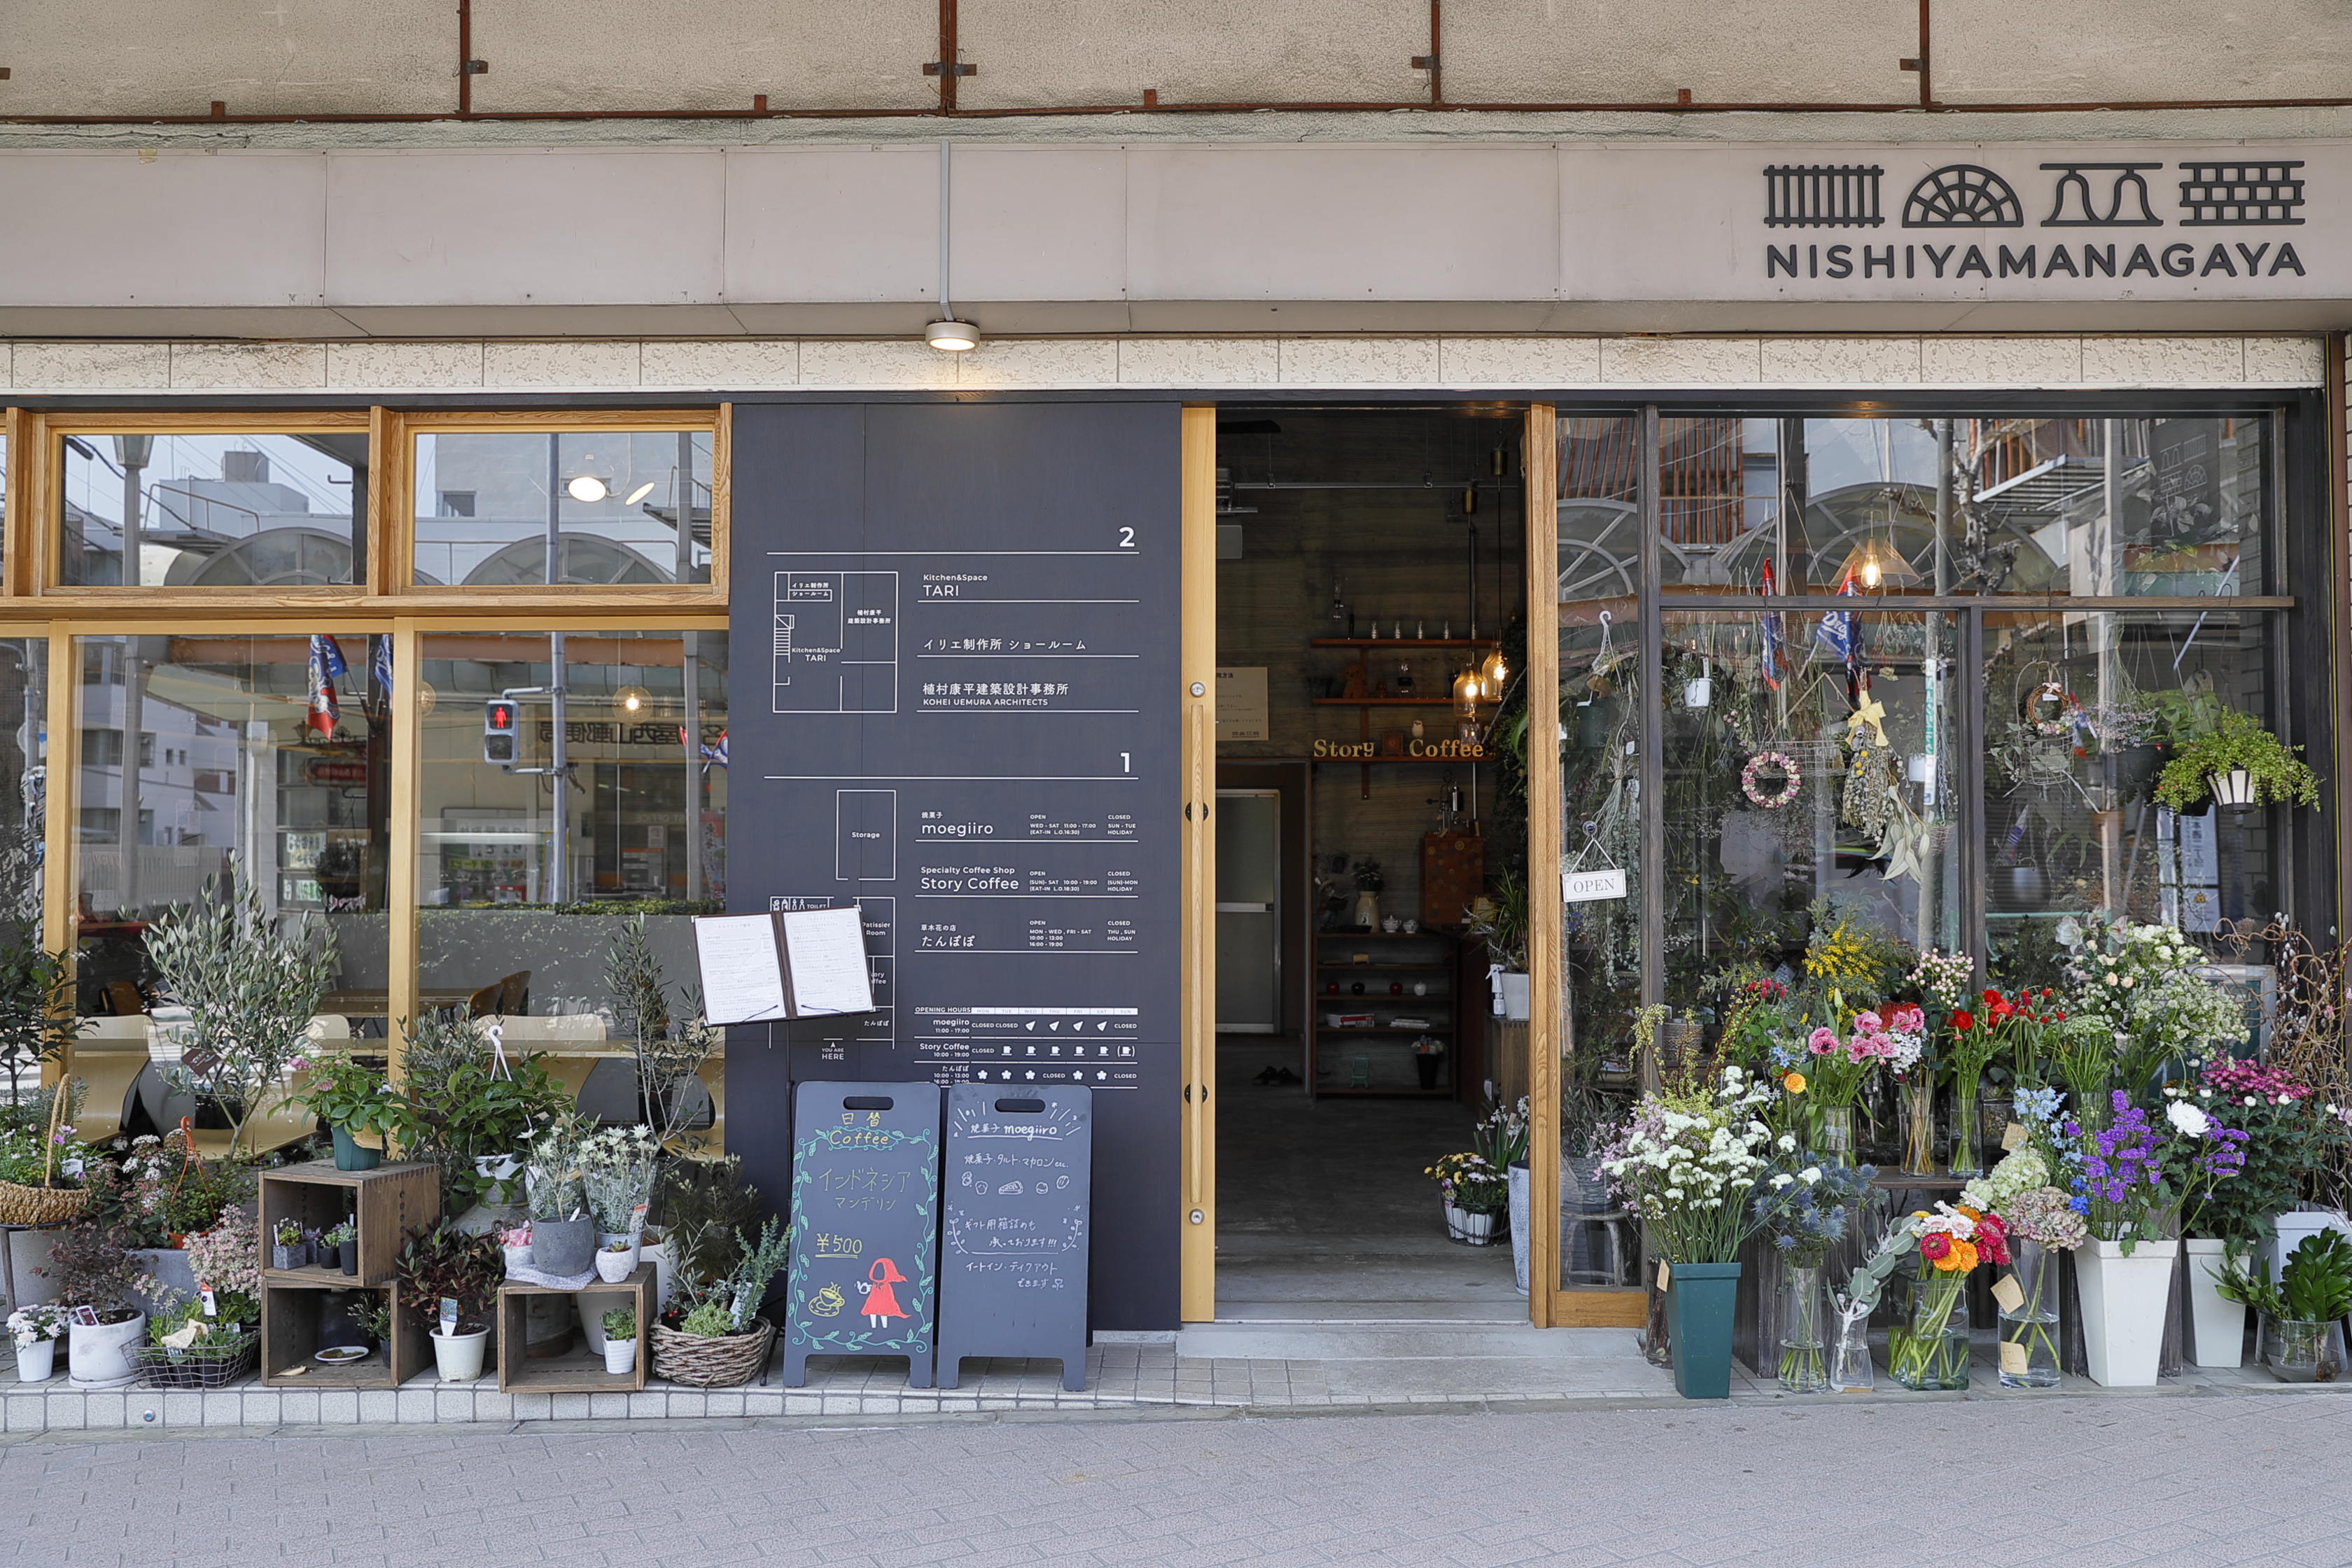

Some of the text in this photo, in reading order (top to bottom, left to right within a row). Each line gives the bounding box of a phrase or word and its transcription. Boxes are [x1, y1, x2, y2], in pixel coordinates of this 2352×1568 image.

[1767, 242, 2306, 279] NISHIYAMANAGAYA
[1119, 526, 1135, 547] 2
[923, 573, 988, 583] Kitchen&Space
[923, 584, 959, 597] TARI
[923, 638, 1086, 651] イリエ制作所 ショールーム
[805, 654, 827, 662] TARI
[922, 682, 1070, 696] 植村康平建築設計事務所
[1314, 738, 1484, 757] Story Coffee
[1120, 752, 1130, 773] 1
[851, 832, 881, 840] Storage
[921, 822, 994, 837] moegiiro
[920, 866, 1016, 875] Specialty Coffee Shop
[920, 877, 1019, 892] Story Coffee
[1573, 878, 1616, 895] OPEN
[922, 934, 976, 948] たんぽぽ
[933, 1018, 970, 1027] moegiiro
[919, 1043, 941, 1051] Story
[830, 1130, 889, 1145] Coffee
[970, 1123, 1058, 1142] 焼菓子 moegiiro
[819, 1167, 911, 1193] インドネシア
[834, 1196, 897, 1211] マンデリン
[965, 1217, 1036, 1231] ギフト用箱詰めも
[1017, 1278, 1049, 1289] できます
